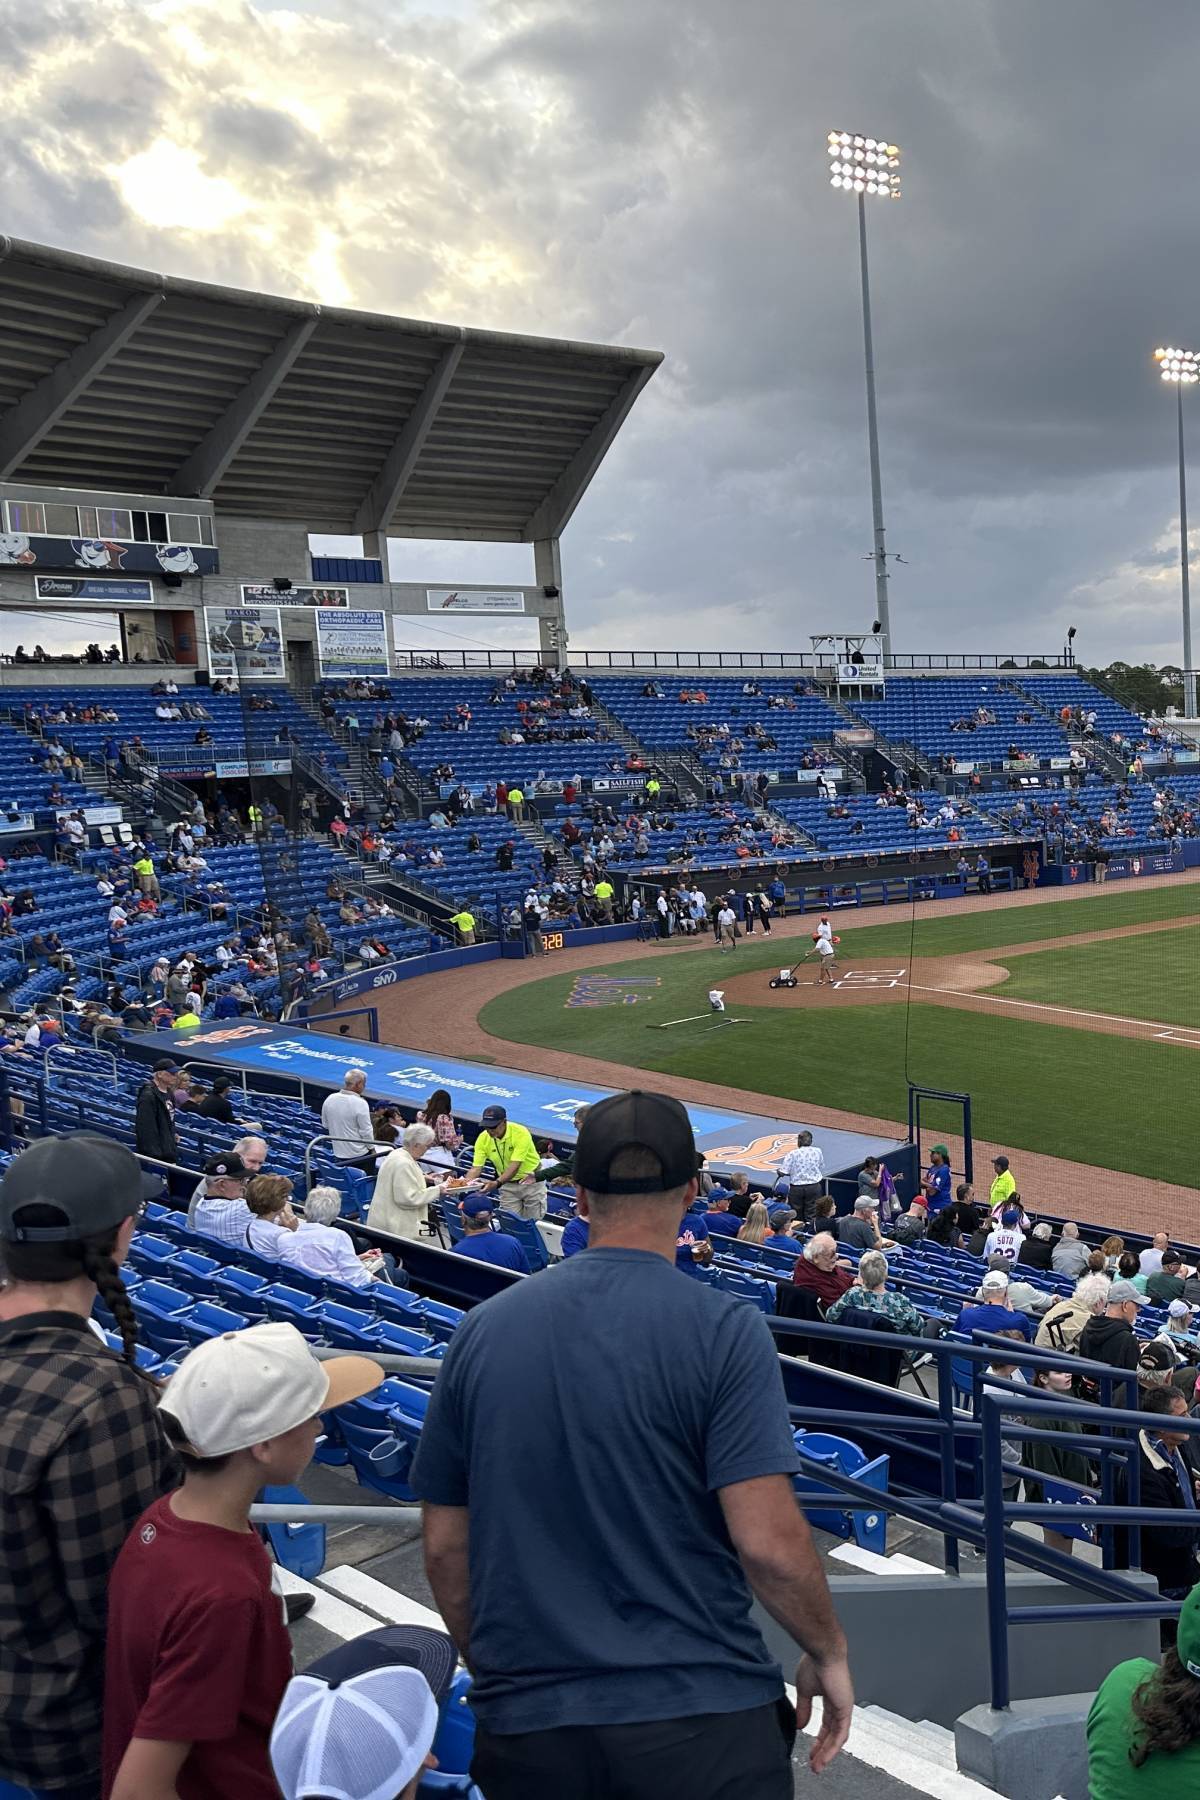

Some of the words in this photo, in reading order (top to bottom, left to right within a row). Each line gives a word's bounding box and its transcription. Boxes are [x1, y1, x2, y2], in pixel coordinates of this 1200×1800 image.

[374, 973, 392, 987] SNY
[416, 1073, 478, 1090] Cleveland
[478, 1085, 520, 1098] Clinic
